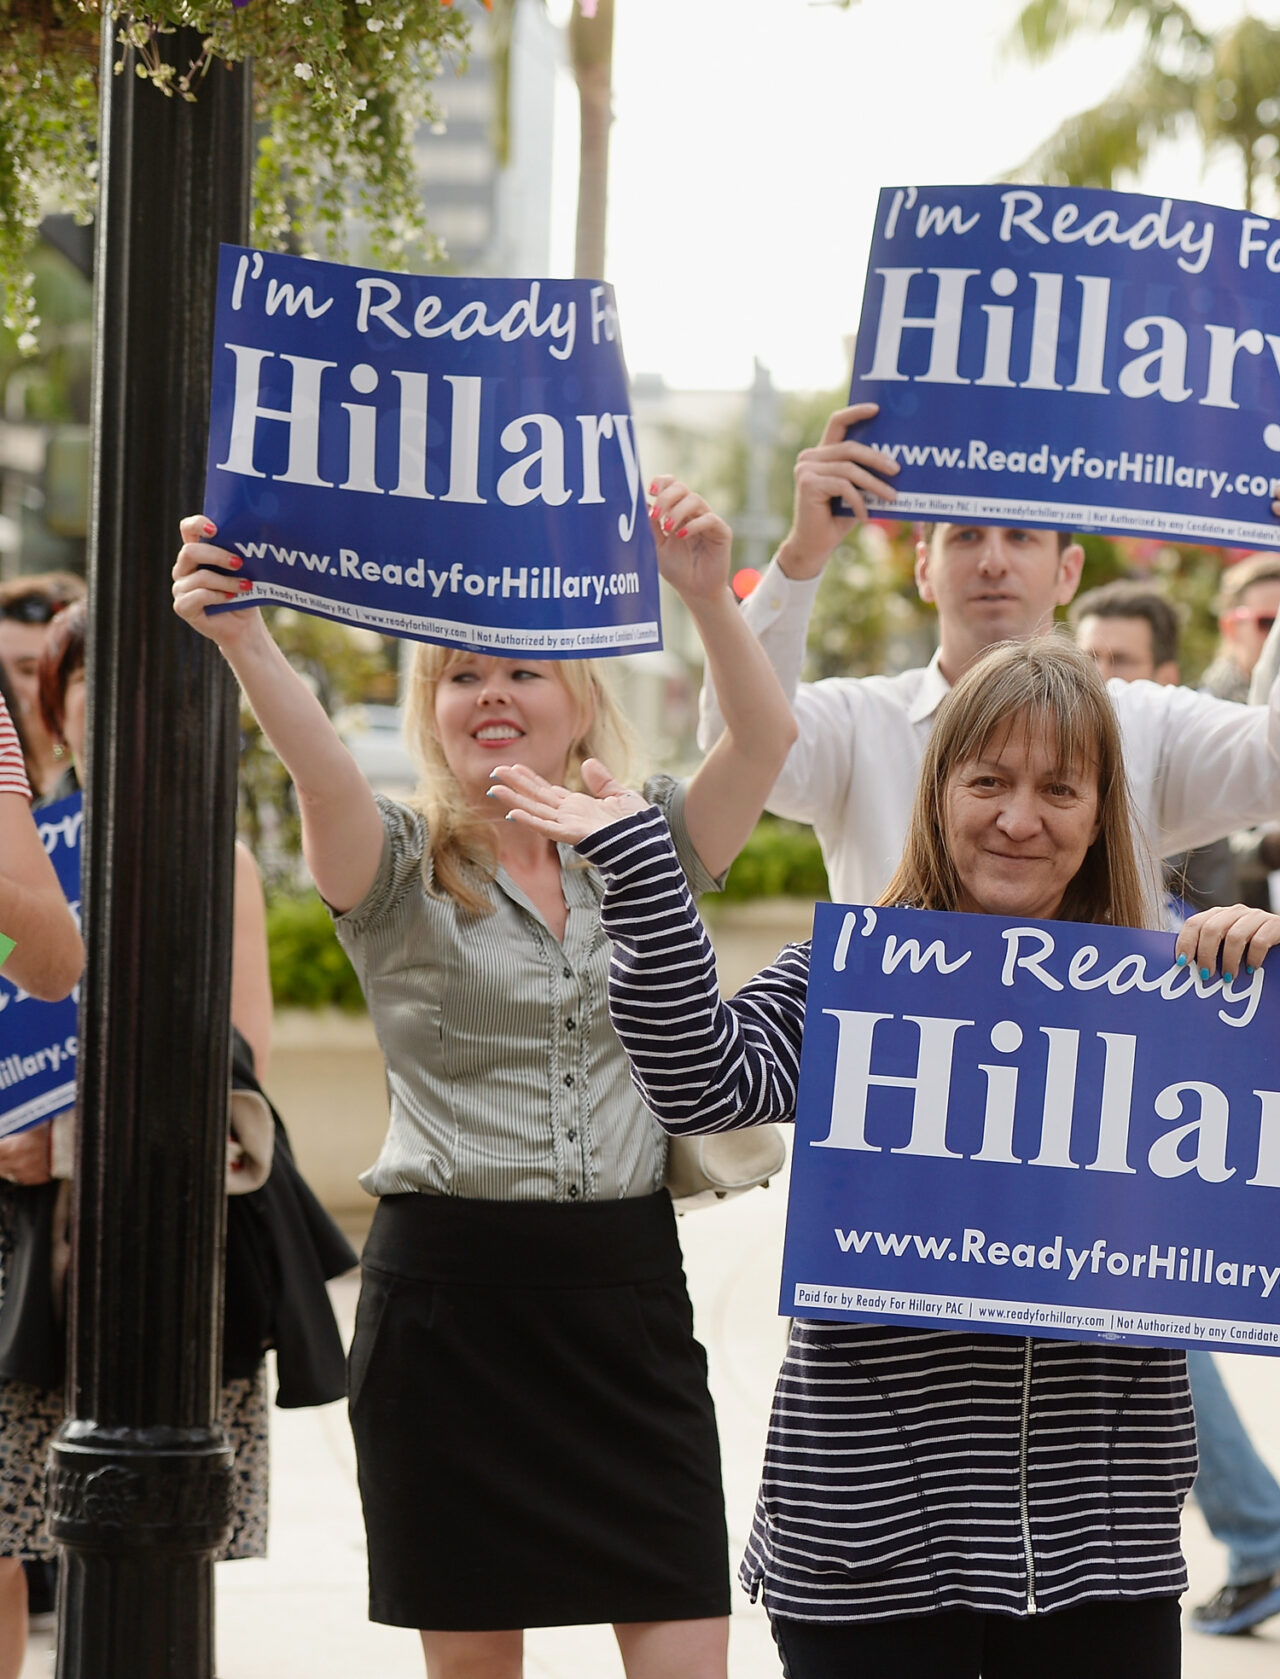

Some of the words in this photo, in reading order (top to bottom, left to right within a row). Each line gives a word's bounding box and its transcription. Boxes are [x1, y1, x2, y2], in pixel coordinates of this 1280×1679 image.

[884, 186, 980, 240] I'm
[1000, 190, 1214, 274] Ready
[231, 252, 334, 319] I'm
[355, 277, 577, 360] Ready
[590, 286, 616, 345] Fo
[216, 343, 640, 542] Hillary
[1110, 512, 1156, 527] Authorized
[234, 542, 640, 604] www.ReadyforHillary.com
[364, 612, 468, 638] www.readyforhillary.com
[477, 630, 492, 643] Not
[494, 633, 545, 646] Authorized
[547, 634, 559, 648] by
[560, 637, 575, 648] any
[39, 811, 82, 855] or
[832, 907, 972, 975] I'm
[1001, 927, 1265, 1028] Ready
[799, 1289, 821, 1304] Paid
[823, 1290, 838, 1305] for
[841, 1291, 853, 1308] by
[856, 1293, 887, 1311] Ready
[890, 1296, 906, 1310] For
[908, 1298, 943, 1316] Hillary
[945, 1300, 965, 1315] PAC
[978, 1304, 1105, 1328] www.readyforhillary.com
[1116, 1315, 1136, 1331] Not
[1137, 1318, 1192, 1335] Authorized
[1194, 1321, 1206, 1338] by
[1208, 1324, 1228, 1340] any
[1230, 1326, 1280, 1344] Candidate
